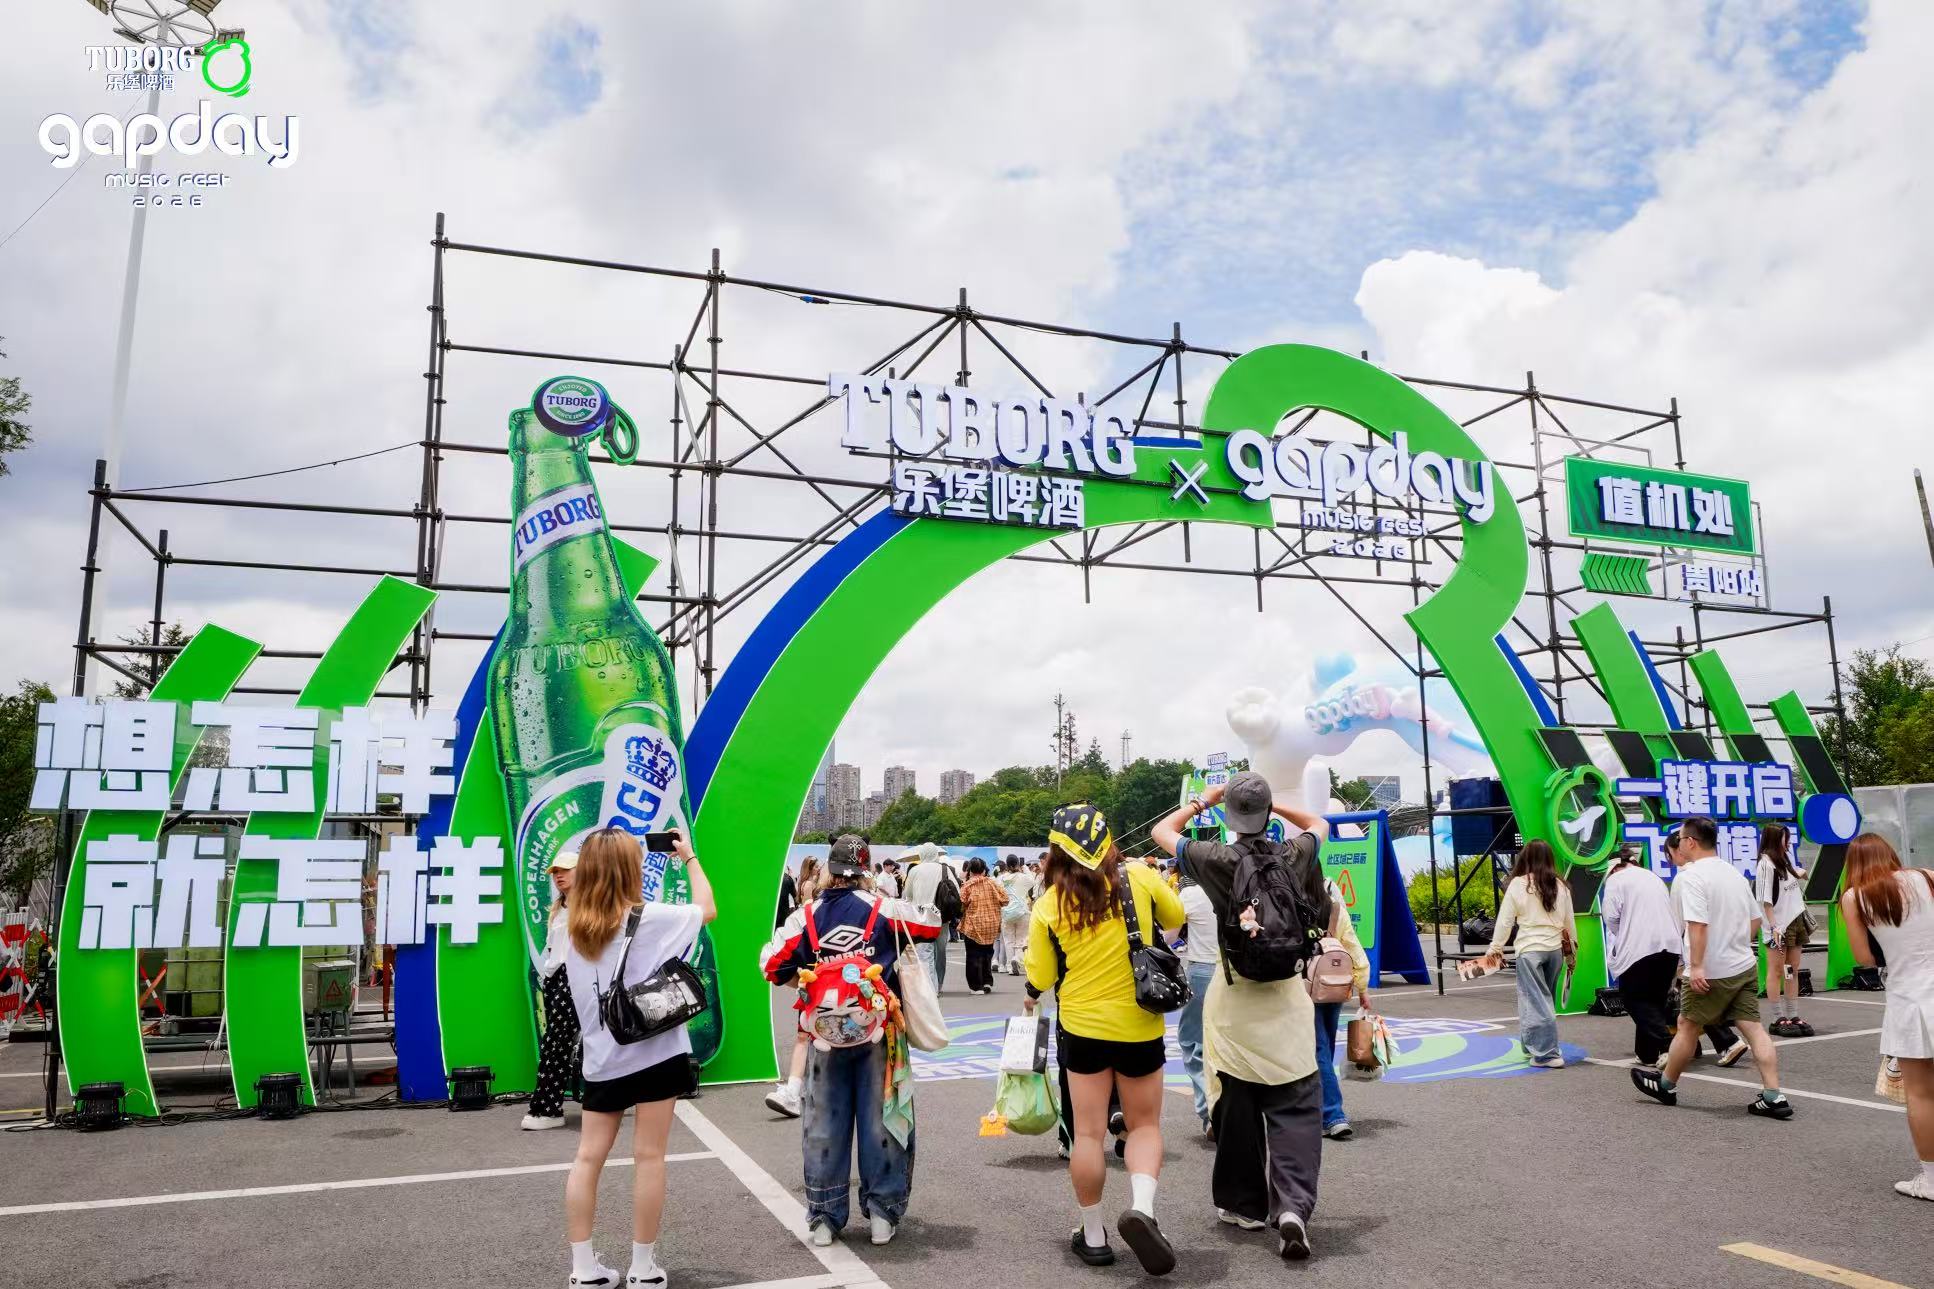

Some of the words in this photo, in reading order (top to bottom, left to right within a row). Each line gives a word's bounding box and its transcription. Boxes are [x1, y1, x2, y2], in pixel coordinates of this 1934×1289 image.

[547, 395, 597, 408] TUBORG
[828, 372, 1138, 477] TUBORG
[892, 461, 1086, 528] 乐堡啤酒
[1224, 430, 1495, 524] gapday
[1597, 475, 1734, 536] 值机处
[514, 493, 603, 559] TUBORG
[1682, 563, 1763, 597] 贵阳站
[28, 696, 458, 814] 想怎样
[1618, 762, 1794, 814] 一键开启
[78, 834, 504, 950] 就怎样
[526, 800, 580, 924] COPENHAGEN
[540, 837, 560, 882] DENMARK
